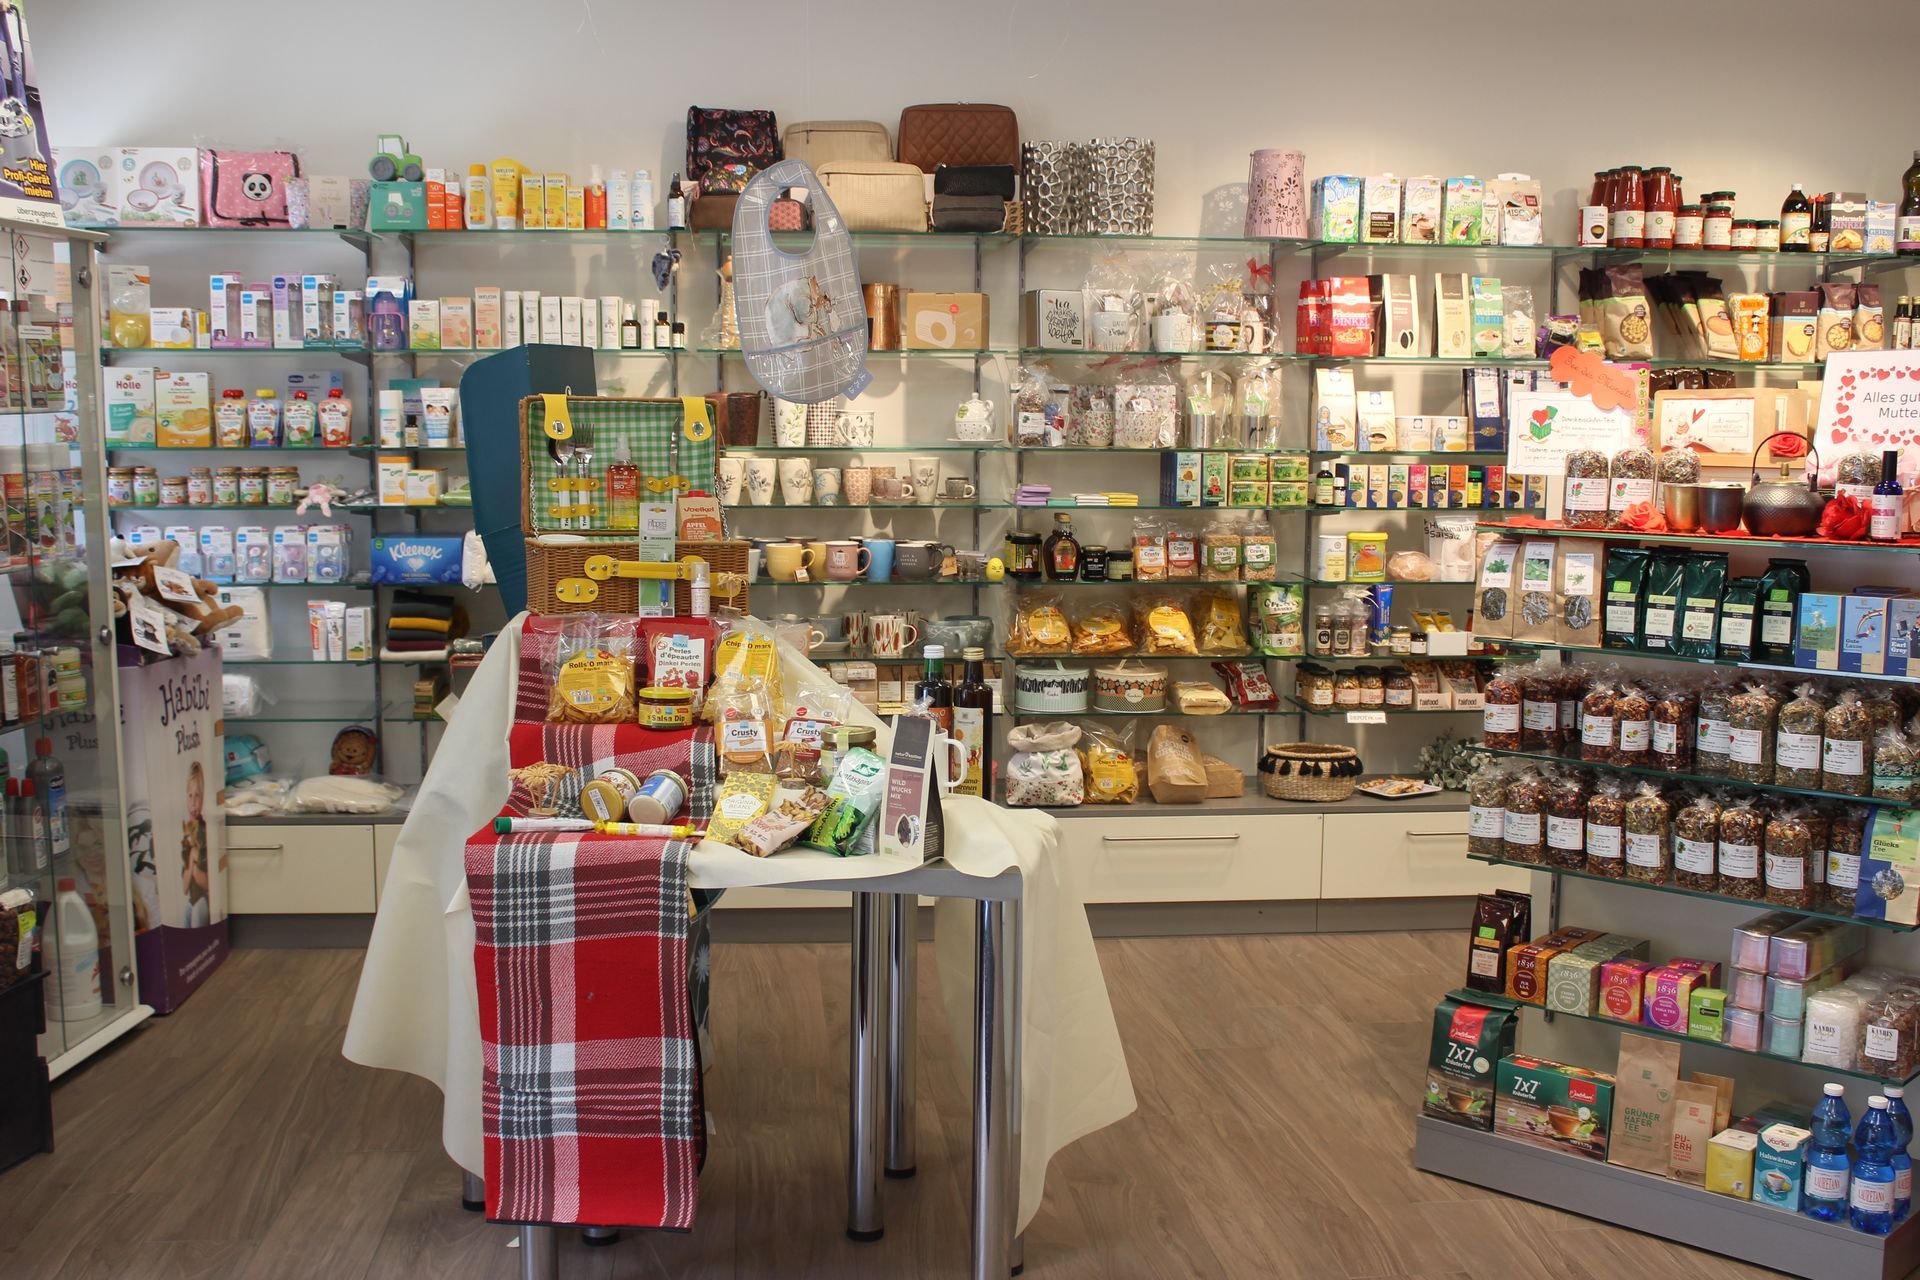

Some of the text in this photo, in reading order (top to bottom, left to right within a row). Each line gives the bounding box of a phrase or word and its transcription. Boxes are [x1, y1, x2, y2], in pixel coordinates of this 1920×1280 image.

[29, 158, 48, 173] Hier
[3, 167, 52, 186] Profi-Gerät
[24, 186, 54, 199] mieten
[1831, 221, 1865, 229] DINKEL
[1332, 317, 1369, 327] DINKEL
[116, 380, 142, 390] Holle
[1863, 392, 1896, 403] Alles
[389, 541, 443, 561] Kleenex
[159, 674, 210, 727] Habibi
[1420, 698, 1439, 706] fairfood
[1458, 698, 1477, 706] fairfood
[652, 712, 686, 722] Salsa Dip
[731, 729, 758, 737] Crusty
[796, 727, 821, 737] Crusty
[66, 732, 98, 751] Plus
[176, 721, 201, 755] Plush
[890, 786, 912, 795] WUCHS
[725, 799, 758, 807] ORIGINAL
[1872, 845, 1887, 853] Tee
[1873, 839, 1900, 849] Glücks
[1517, 958, 1535, 970] 1836
[1560, 969, 1579, 980] 1836
[1609, 973, 1629, 985] 1836
[1657, 984, 1677, 996] 1836
[1447, 1042, 1475, 1062] 7x7
[1513, 1076, 1539, 1094] 7x7
[1624, 1107, 1660, 1121] GRÜNER
[1624, 1115, 1652, 1128] HAFER
[1624, 1122, 1640, 1132] TEE
[1674, 1133, 1691, 1142] PU-
[1673, 1141, 1692, 1152] ERH
[1759, 1151, 1797, 1167] Halswärmer
[1814, 1176, 1840, 1190] LAURETANA
[1858, 1189, 1885, 1203] LAURETANA
